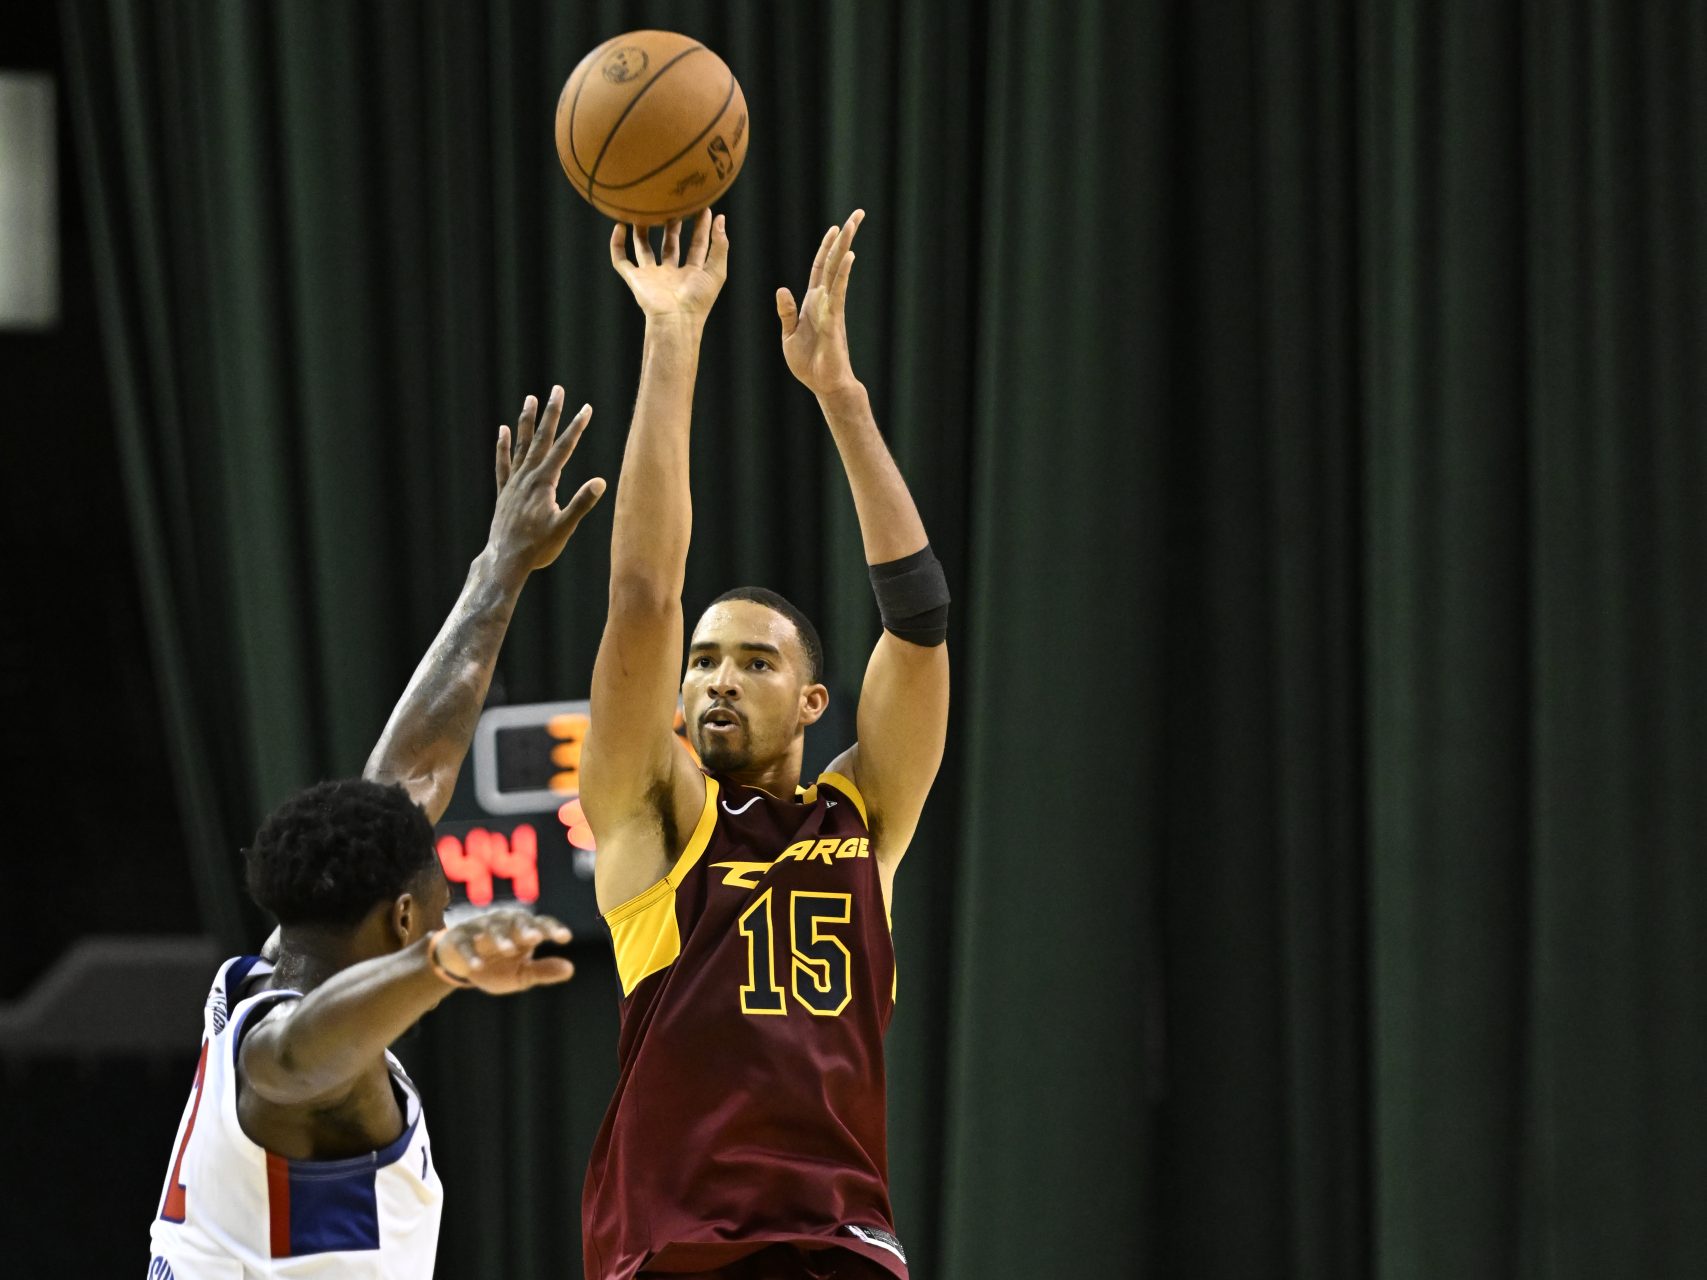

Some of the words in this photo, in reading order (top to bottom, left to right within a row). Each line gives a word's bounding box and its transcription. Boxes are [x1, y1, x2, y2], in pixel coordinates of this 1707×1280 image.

[433, 823, 540, 908] 44
[708, 837, 870, 890] CARGE
[738, 886, 852, 1016] 15
